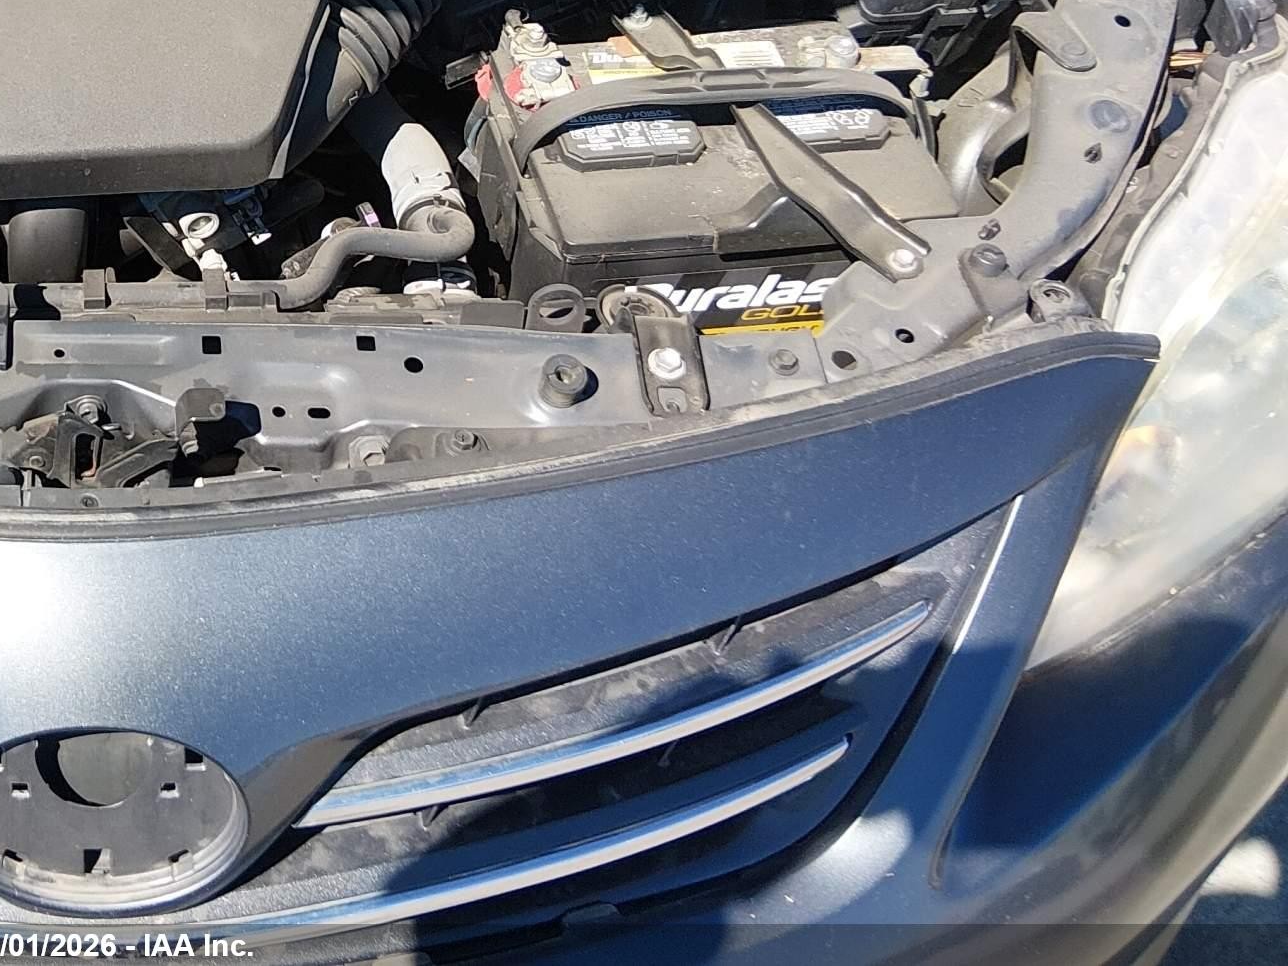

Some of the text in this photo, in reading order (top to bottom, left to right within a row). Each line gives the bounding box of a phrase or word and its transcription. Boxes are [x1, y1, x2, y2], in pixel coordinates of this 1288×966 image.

[580, 113, 623, 123] DANGER
[632, 109, 673, 119] POISON
[624, 273, 841, 313] uralas
[741, 304, 824, 321] GOL
